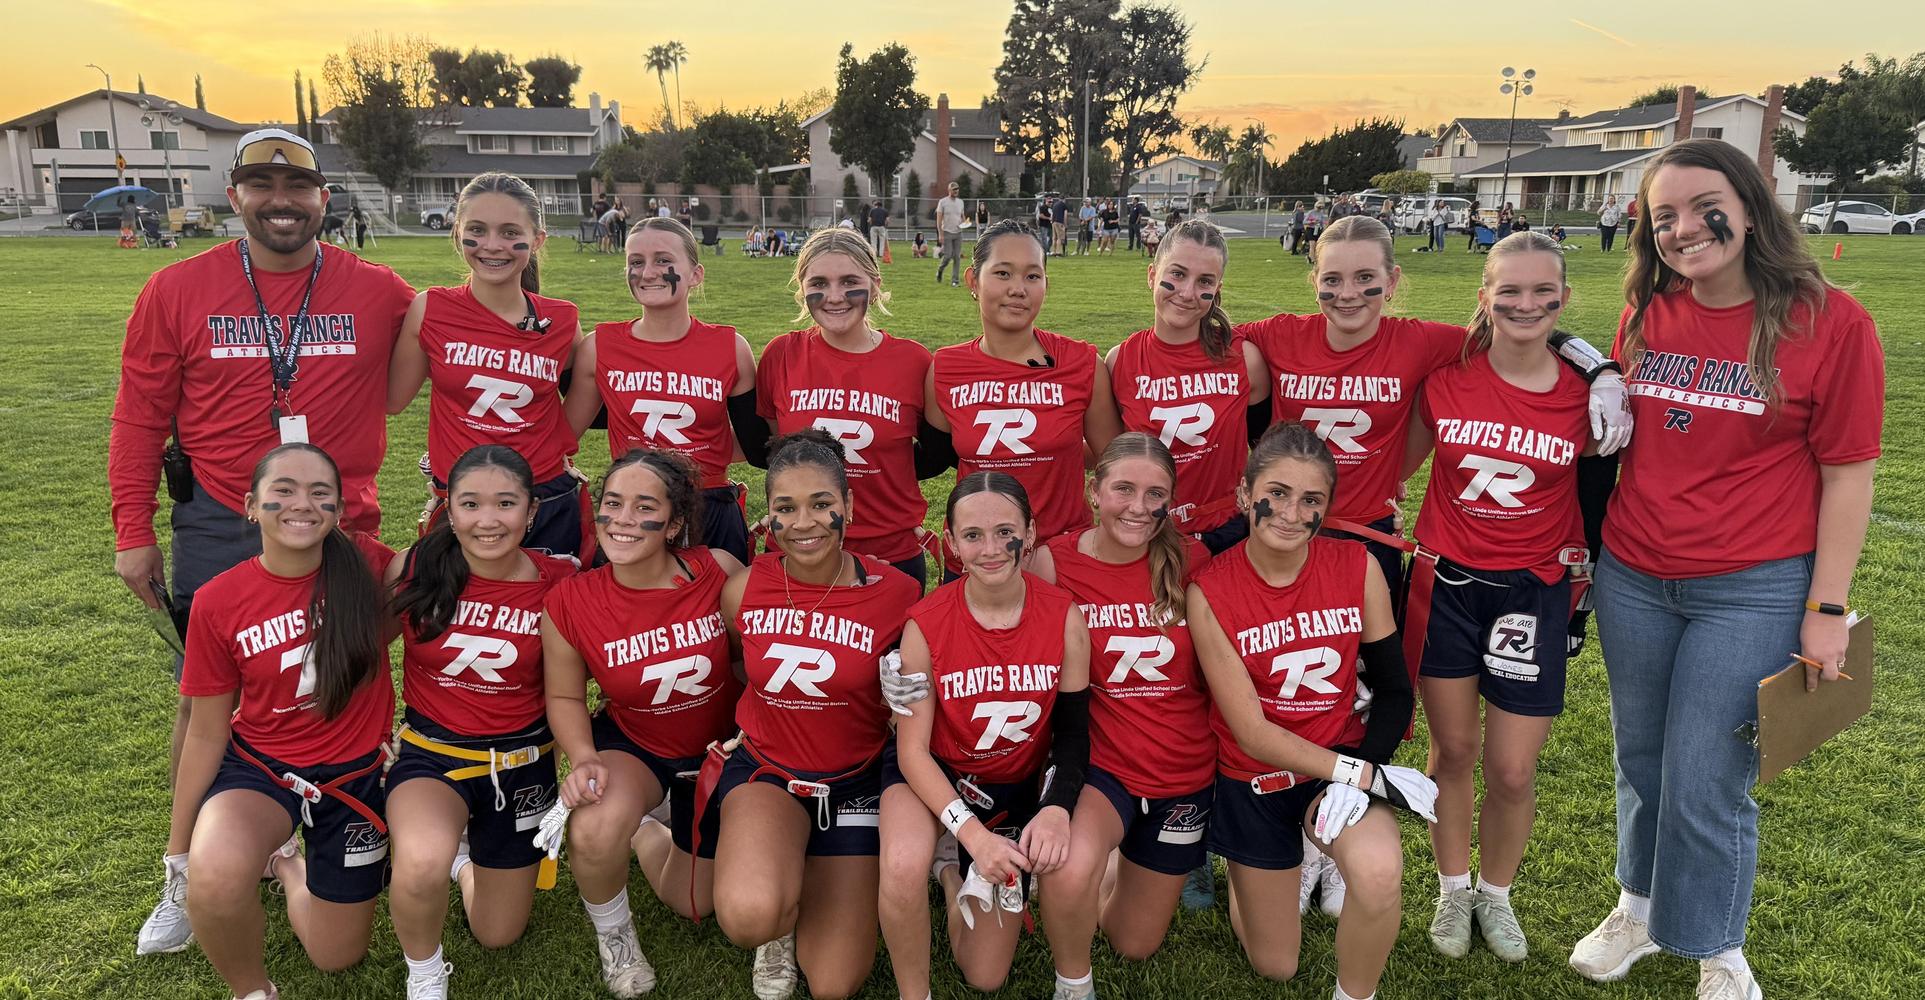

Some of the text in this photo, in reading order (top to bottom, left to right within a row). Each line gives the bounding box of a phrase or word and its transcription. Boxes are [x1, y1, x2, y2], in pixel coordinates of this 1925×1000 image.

[208, 314, 284, 345] TRAVS
[444, 341, 559, 383] TRAVIS RANCH
[1631, 350, 1780, 400] RAVIS RANC
[464, 373, 535, 424] TR
[607, 370, 723, 402] TRAVIS RANCH
[789, 388, 902, 424] TRAVIS RANCH
[949, 381, 1065, 409] TRAVIS RANCH
[1135, 372, 1240, 402] RAVIS RANCH
[1279, 373, 1402, 402] TRAVIS RANCH
[629, 398, 697, 445] TR
[972, 408, 1038, 456] TR
[1149, 401, 1215, 450] TR
[1299, 407, 1373, 453] TR
[1436, 418, 1576, 466] TRAVIS RANCH
[1664, 407, 1693, 433] TR
[1456, 453, 1536, 508] TR
[236, 608, 306, 659] TRAVIS
[449, 599, 543, 636] AVIS RANC
[742, 608, 875, 654] TRAVIS RANCH
[1236, 606, 1363, 657] TRAVIS RANCH
[1495, 627, 1541, 654] TR
[1516, 619, 1533, 629] are
[440, 631, 519, 683] TR
[603, 626, 670, 668] TRAVIS
[761, 642, 836, 698] TR
[1103, 635, 1176, 683] TR
[640, 654, 713, 705] TR
[940, 664, 1061, 701] TRAVIS RANC
[1268, 646, 1343, 700] TR
[1505, 672, 1538, 682] EDUCATION
[970, 700, 1042, 751] TR
